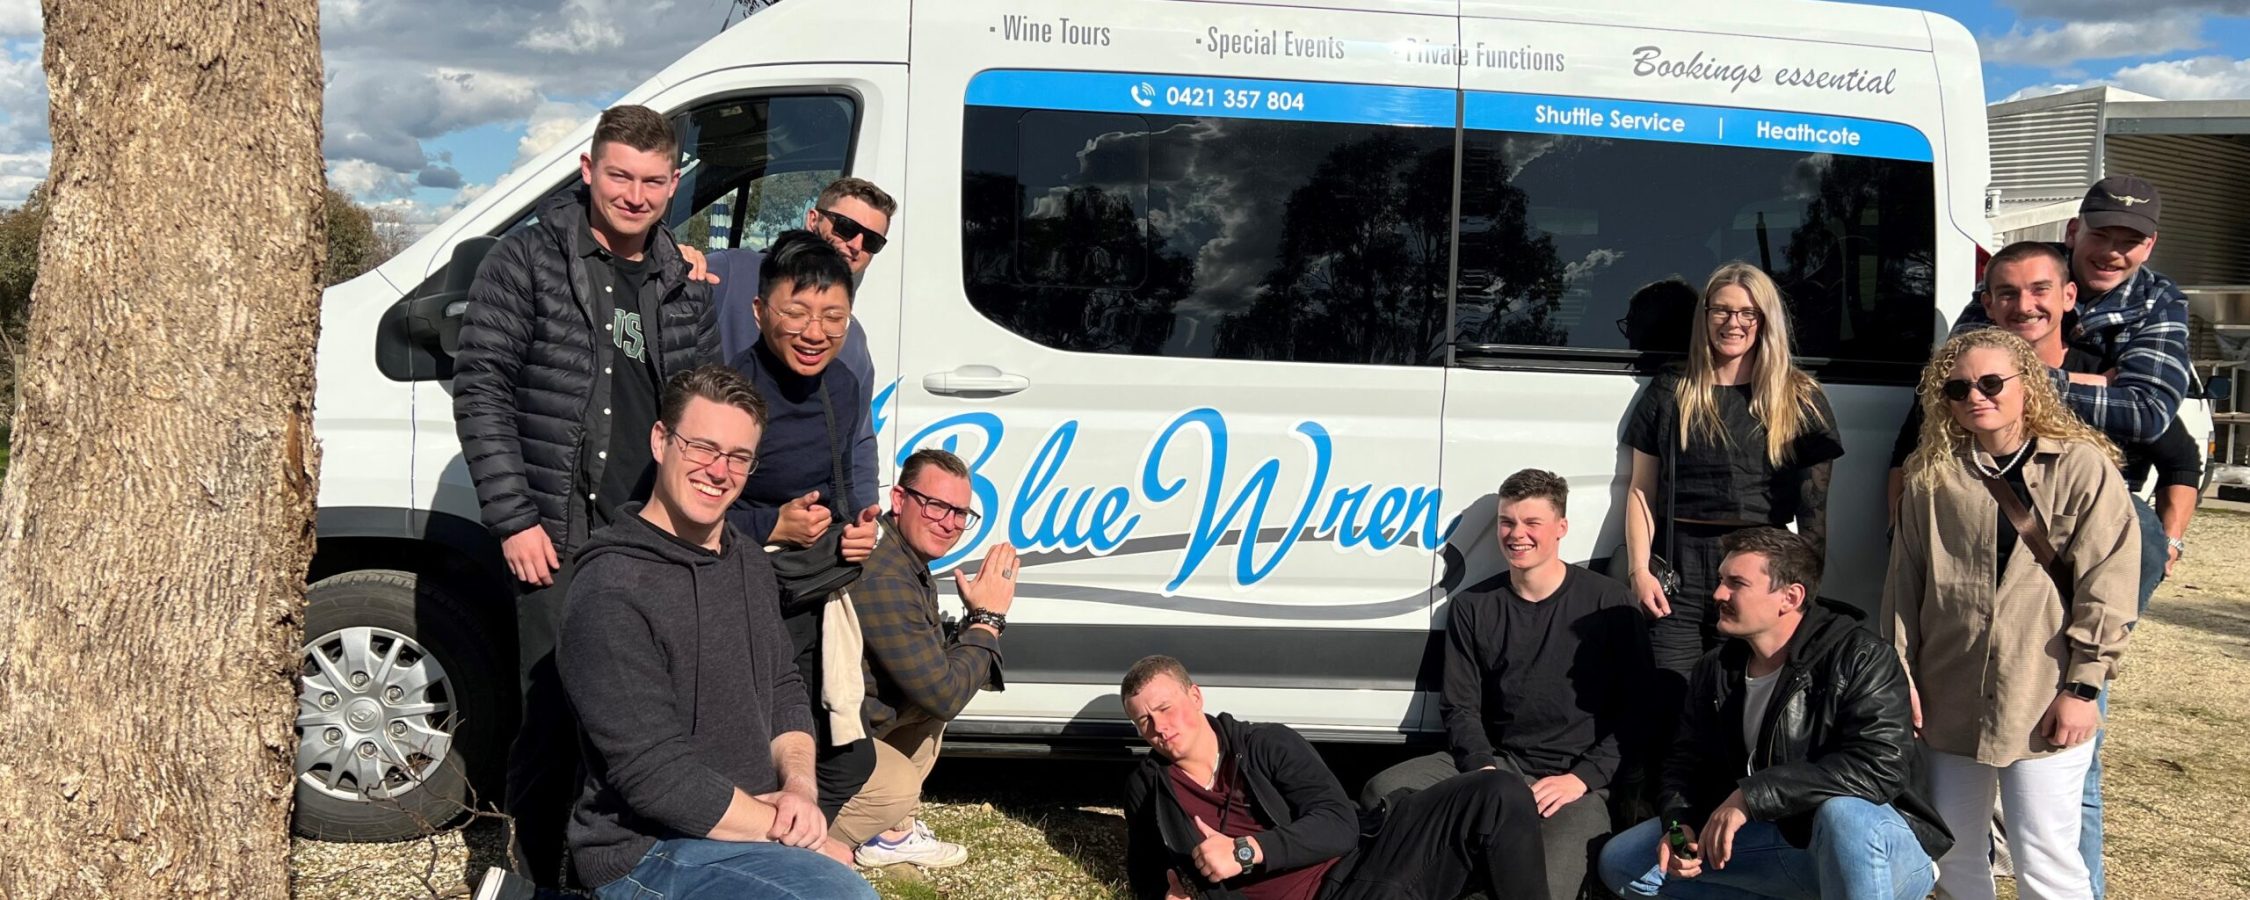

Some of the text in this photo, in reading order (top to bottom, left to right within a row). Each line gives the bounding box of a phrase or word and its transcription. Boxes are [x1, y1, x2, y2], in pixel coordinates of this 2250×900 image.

[1003, 14, 1111, 46] Wine Tours
[1207, 26, 1345, 59] Special Events
[1477, 42, 1565, 72] Functions
[1632, 46, 1897, 95] Bookings essential
[1166, 87, 1304, 112] 0421 357 804
[1535, 105, 1861, 146] Shuttle Service Heathcote
[897, 408, 1463, 592] Blue Wren
